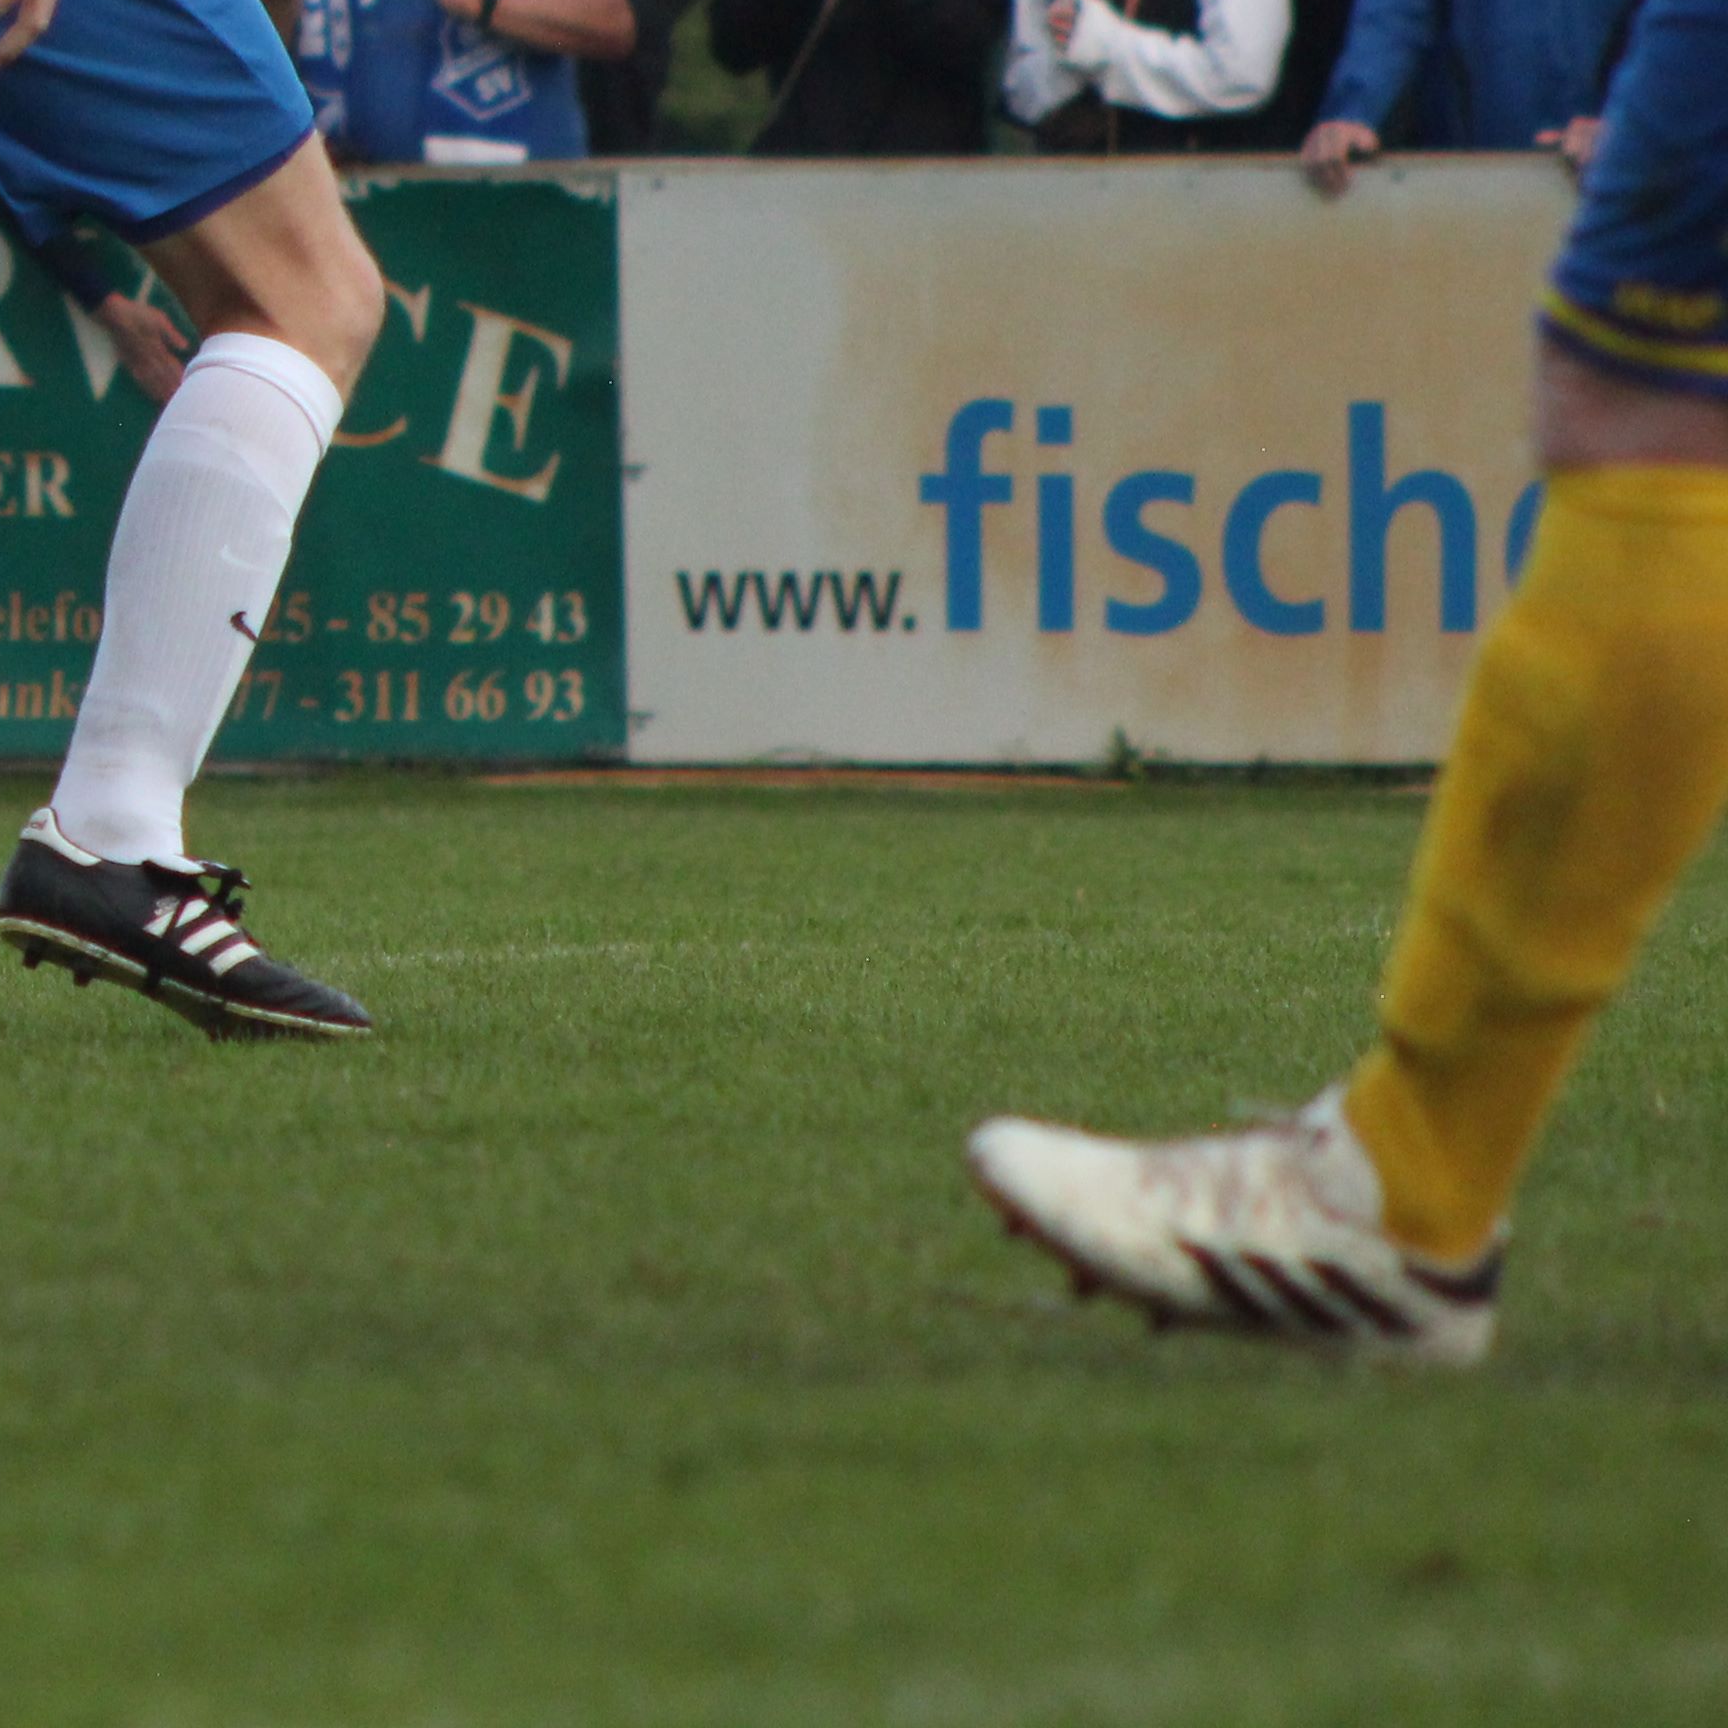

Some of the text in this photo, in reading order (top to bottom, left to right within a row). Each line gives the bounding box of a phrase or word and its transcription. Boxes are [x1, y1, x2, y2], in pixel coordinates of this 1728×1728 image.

[259, 591, 313, 644] 25
[366, 591, 430, 644] 85
[448, 591, 511, 644] 29
[525, 591, 587, 644] 43
[232, 670, 283, 722] 77
[334, 670, 422, 722] 311
[446, 670, 507, 722] 66
[523, 670, 585, 722] 93
